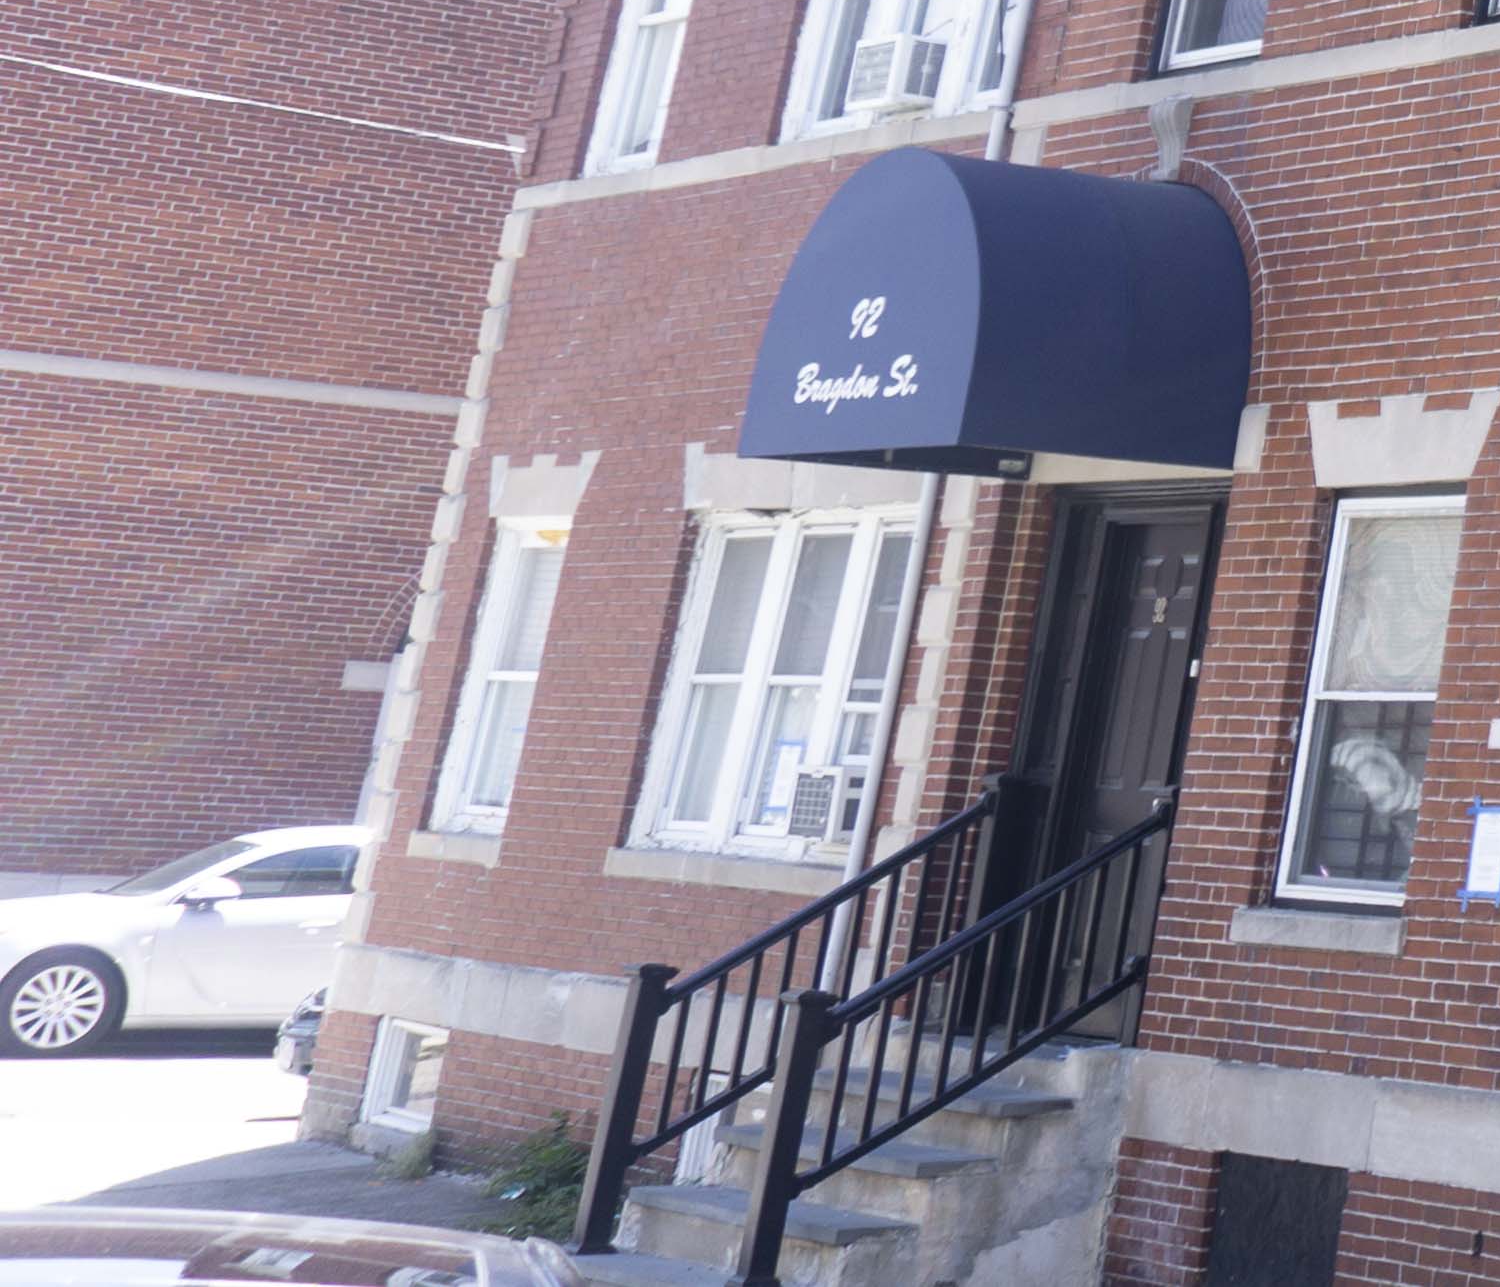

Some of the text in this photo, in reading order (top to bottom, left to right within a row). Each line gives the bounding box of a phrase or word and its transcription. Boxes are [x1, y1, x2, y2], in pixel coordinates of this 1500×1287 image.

[849, 296, 886, 340] 92
[793, 354, 919, 415] Bragdon St.
